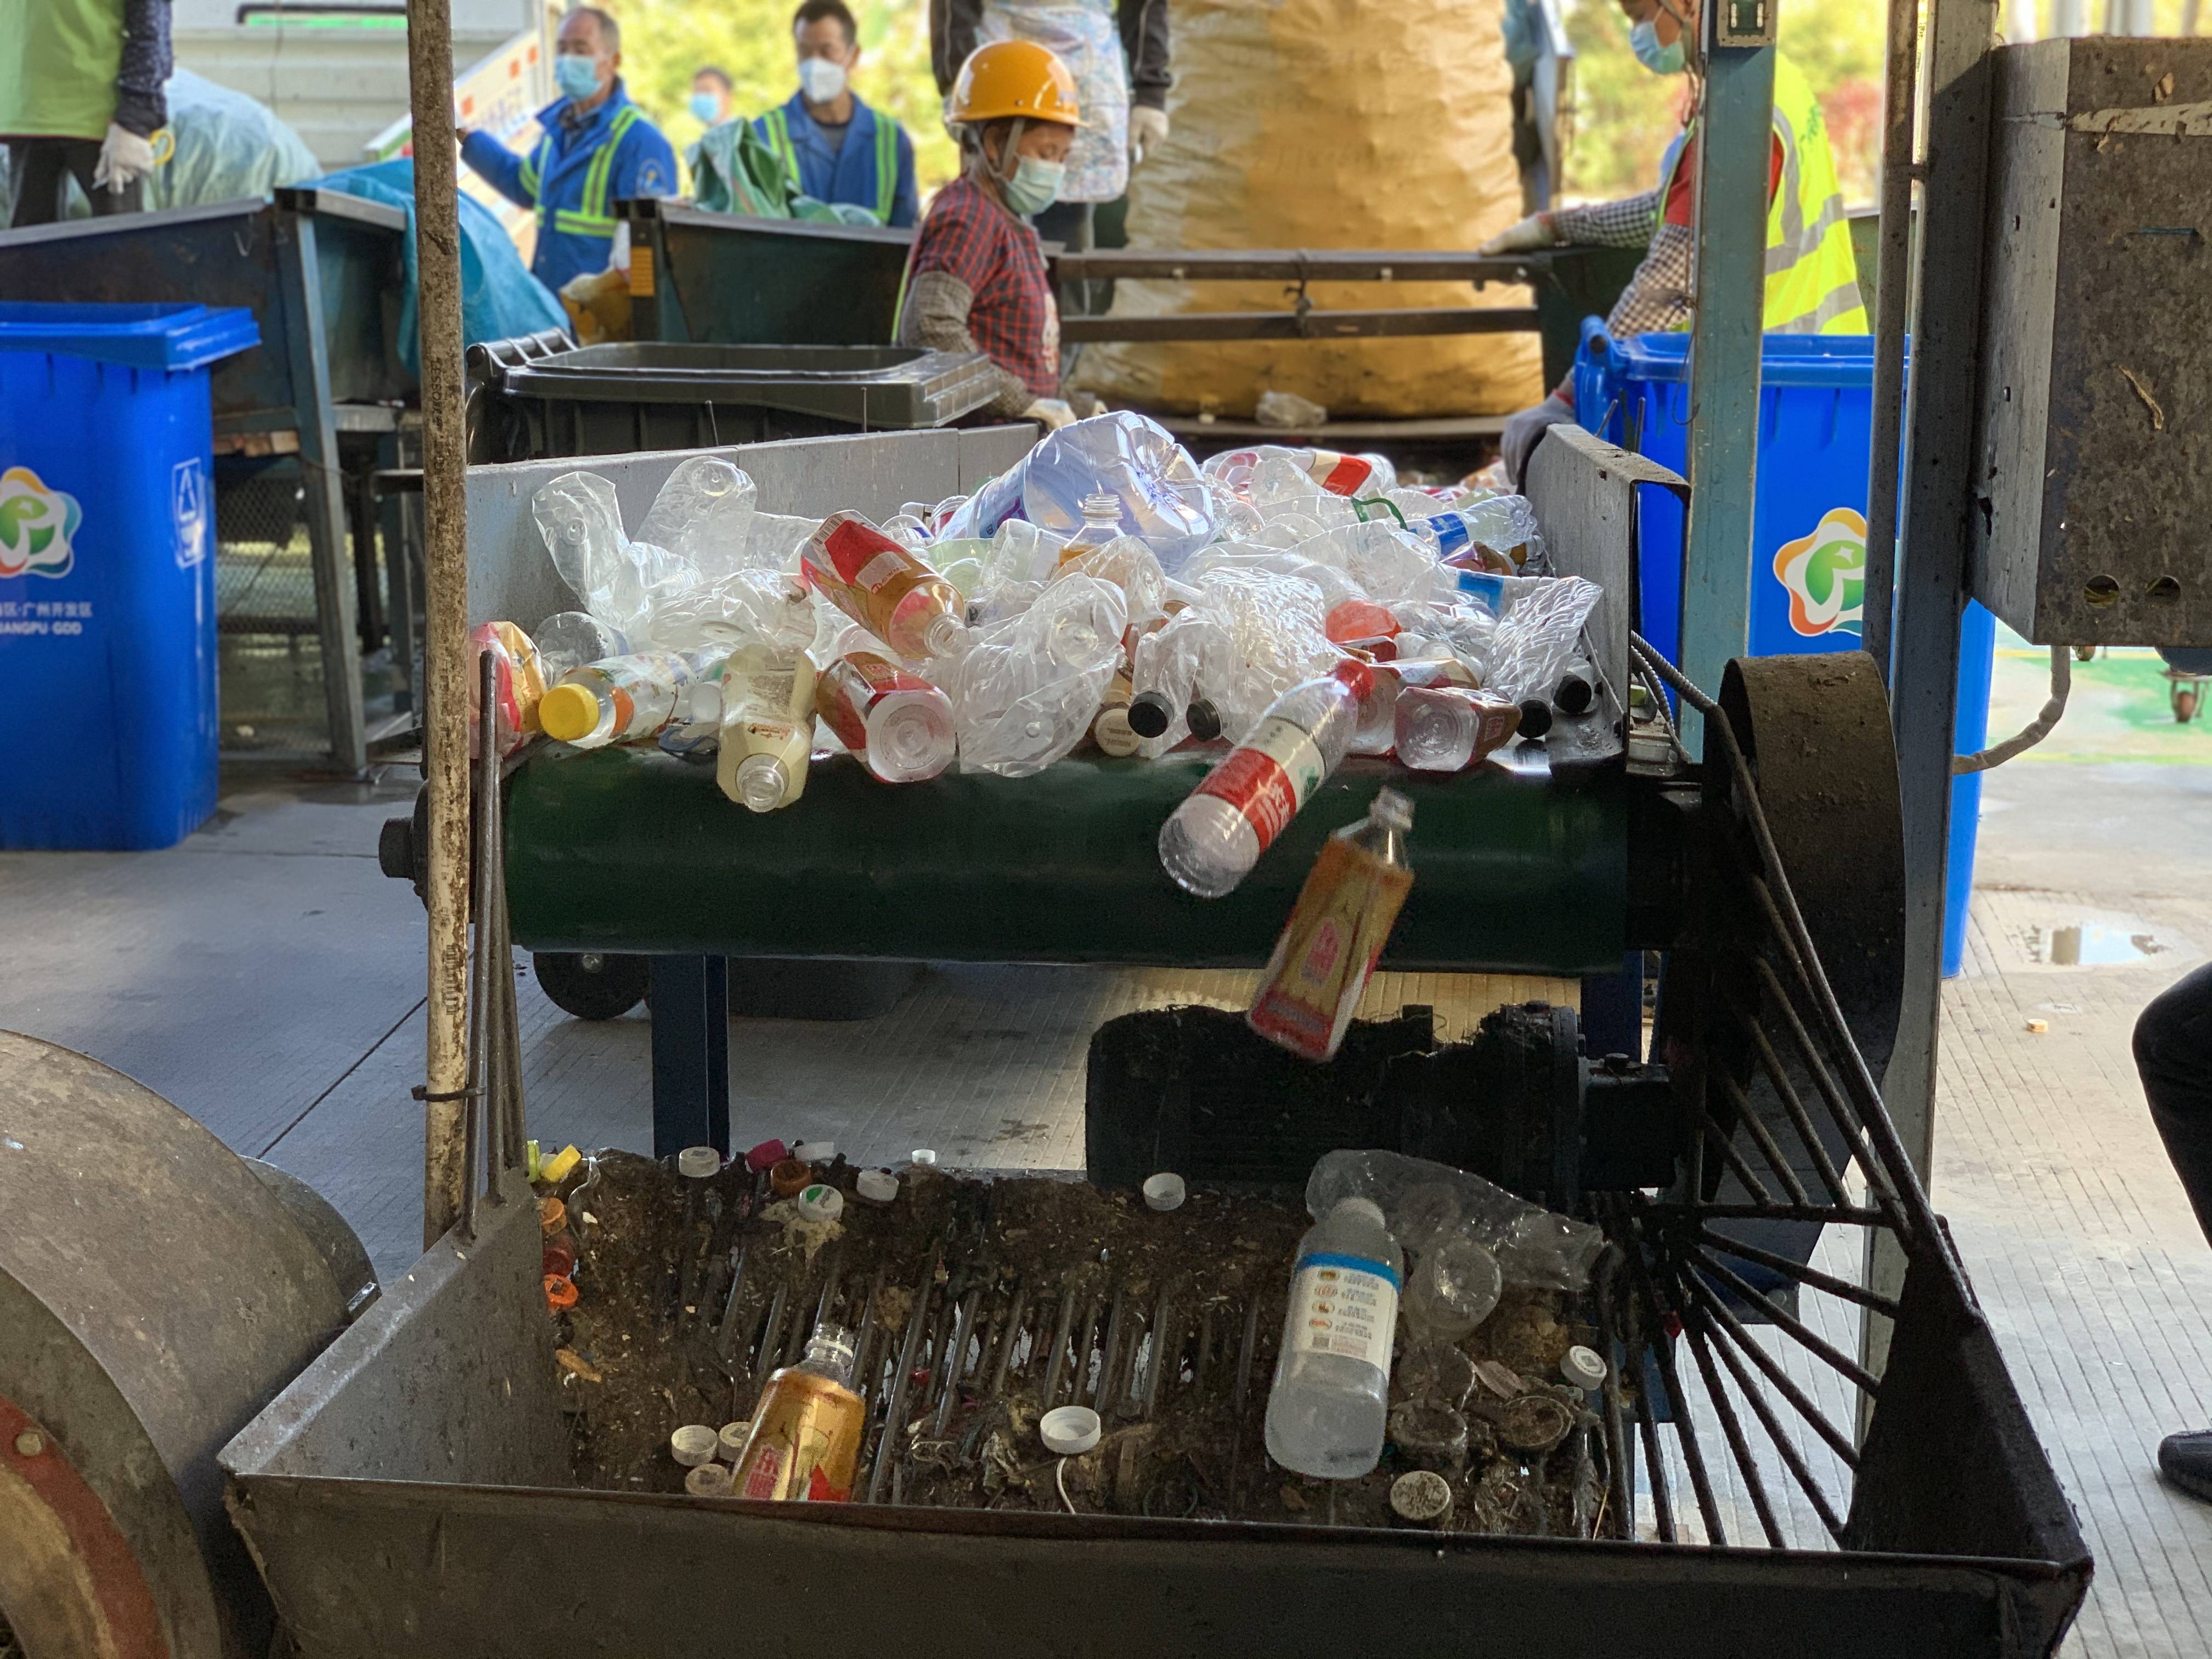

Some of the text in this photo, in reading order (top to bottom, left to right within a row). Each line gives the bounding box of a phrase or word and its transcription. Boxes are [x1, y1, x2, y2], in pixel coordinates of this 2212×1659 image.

[0, 601, 93, 618] 区·广州开发区
